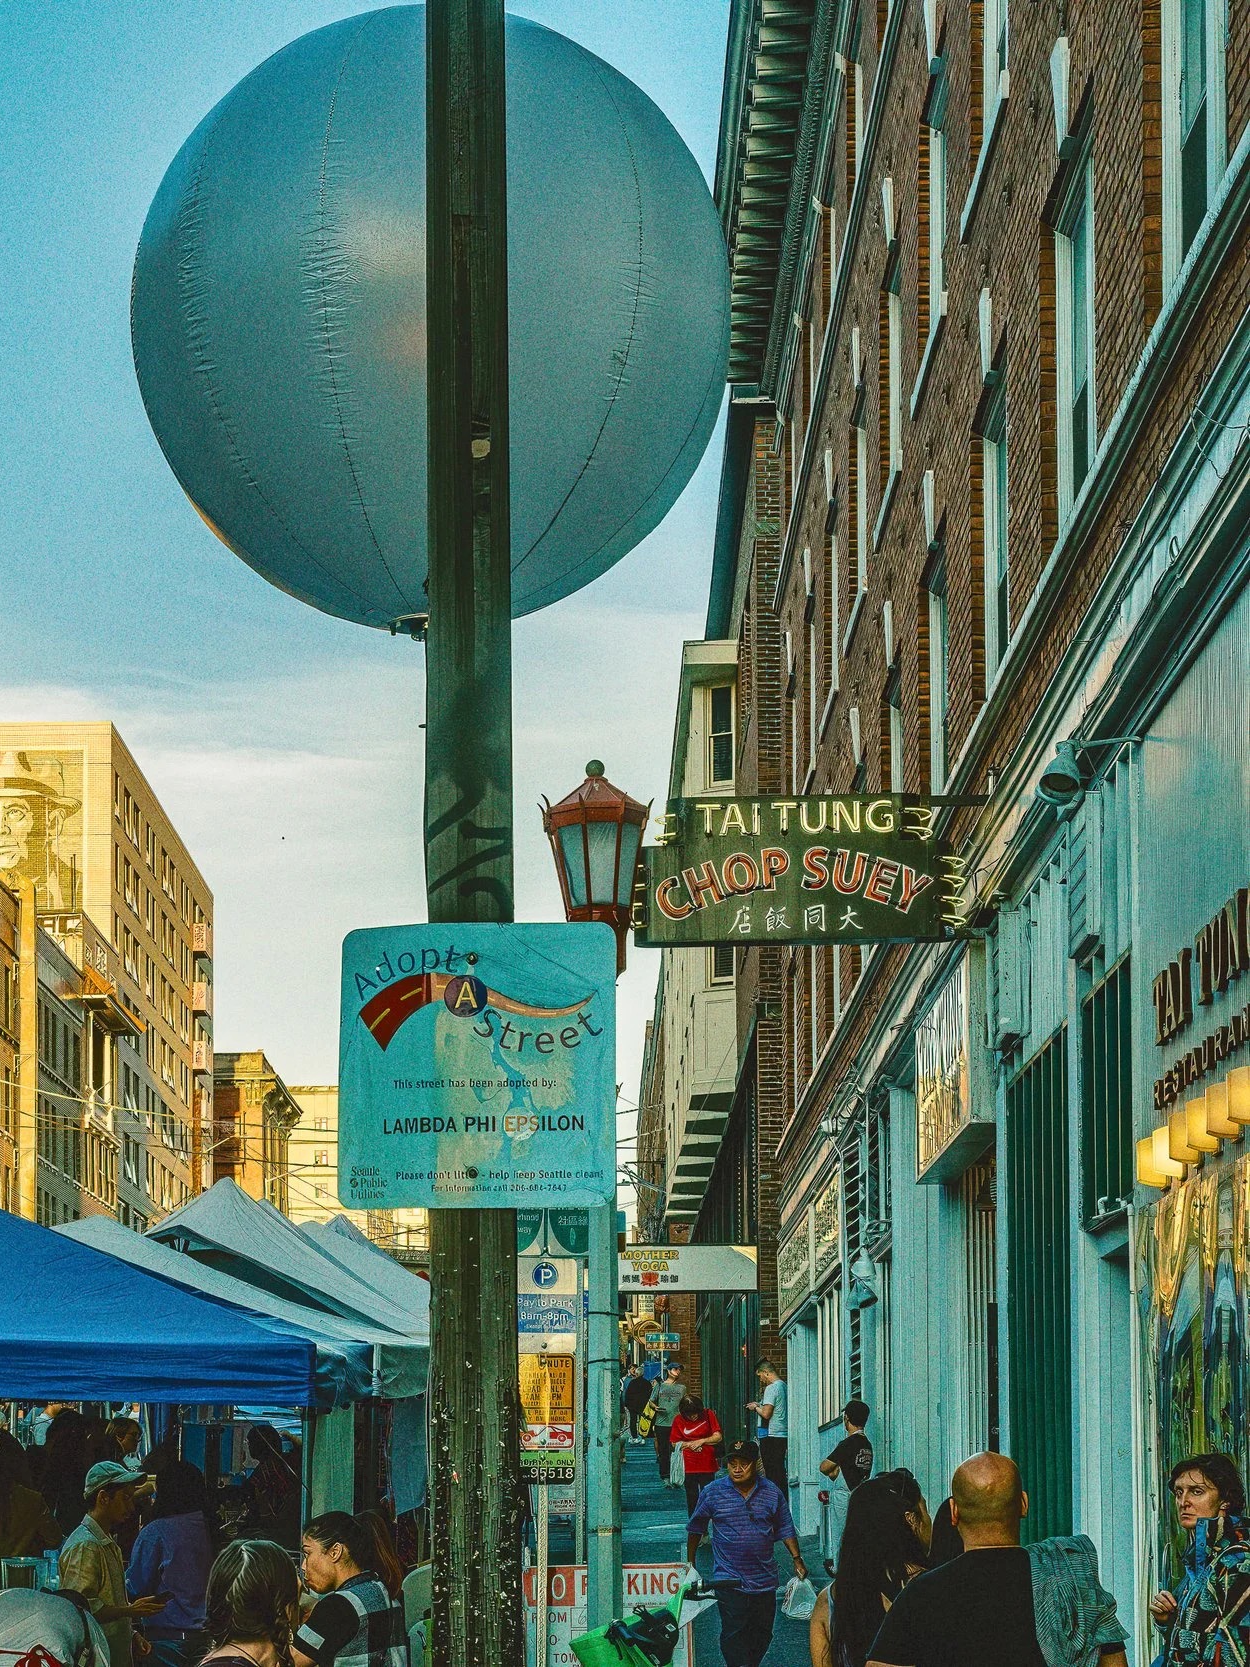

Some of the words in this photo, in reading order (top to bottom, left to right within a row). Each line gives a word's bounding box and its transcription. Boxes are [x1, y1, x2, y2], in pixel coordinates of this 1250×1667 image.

[696, 801, 761, 837] TAI
[770, 799, 894, 836] TUNG
[655, 846, 790, 921] CHOP
[801, 845, 934, 915] SUEY
[1152, 947, 1192, 1046] TAI
[1194, 887, 1250, 1005] TUN
[354, 944, 461, 1001] Adopt
[473, 1009, 603, 1054] Street
[1153, 1002, 1250, 1111] RESTAURAN
[393, 1079, 413, 1089] This
[415, 1080, 445, 1088] street
[448, 1079, 466, 1088] has
[469, 1078, 494, 1088] been
[496, 1078, 538, 1089] adopted
[541, 1078, 557, 1089] by:
[383, 1115, 457, 1134] LAMBDA
[464, 1115, 496, 1133] PHI
[504, 1114, 584, 1132] EPSILON
[395, 1171, 424, 1180] Please
[427, 1170, 451, 1180] don't
[489, 1170, 510, 1180] help
[513, 1170, 536, 1180] keep
[538, 1169, 572, 1179] Seattle
[360, 1179, 388, 1188] Public
[621, 1249, 680, 1260] MOTHER
[631, 1261, 670, 1272] YOGA
[517, 1298, 535, 1308] Pay
[549, 1297, 574, 1307] Park
[520, 1311, 569, 1324] 8am-8pm
[530, 1467, 574, 1479] 95518
[532, 1611, 567, 1624] FOM
